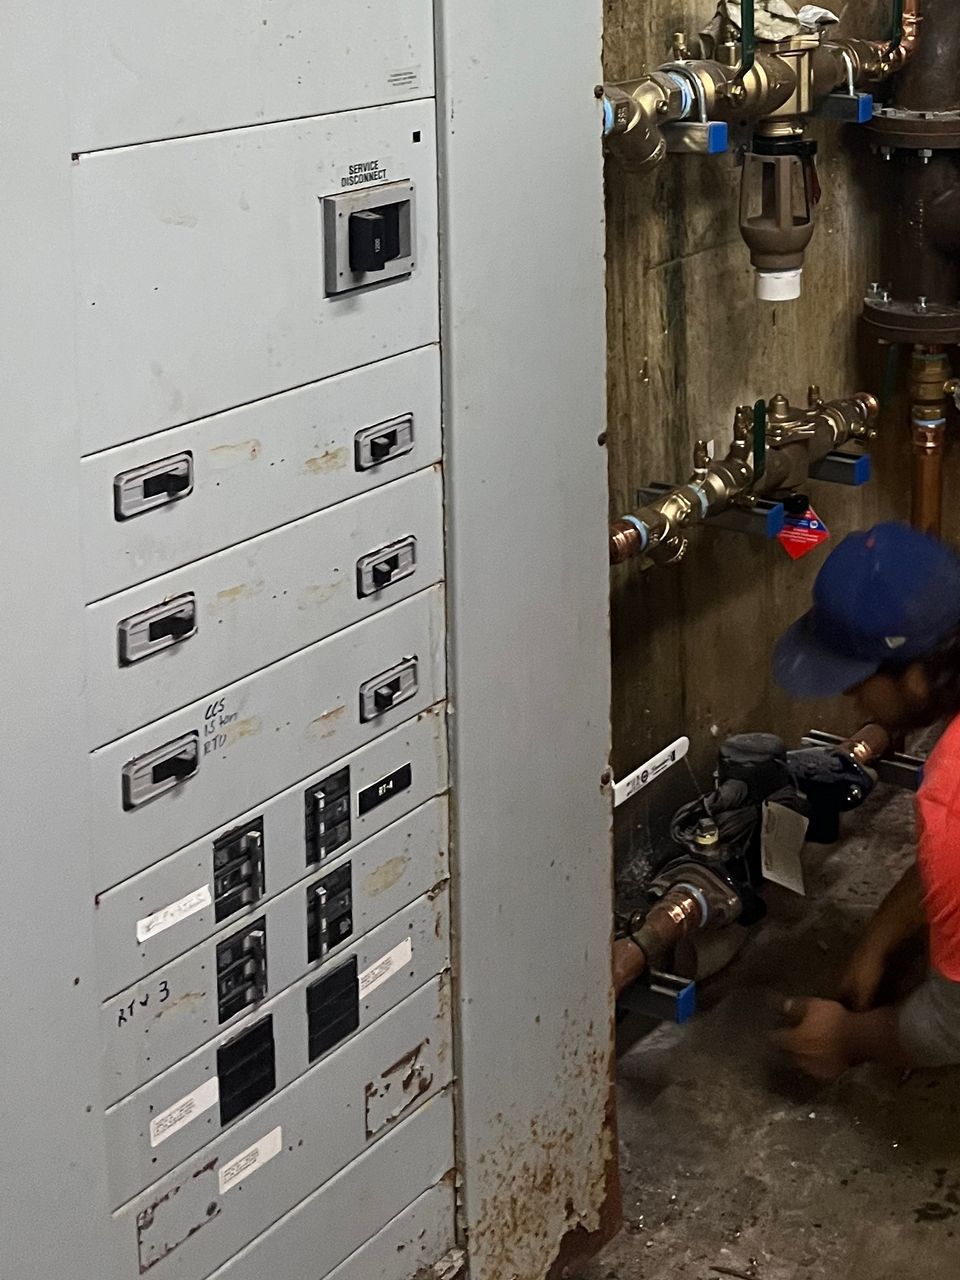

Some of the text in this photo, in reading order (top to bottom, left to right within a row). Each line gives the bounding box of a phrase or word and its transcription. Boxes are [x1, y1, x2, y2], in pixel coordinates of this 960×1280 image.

[349, 160, 379, 175] SERVICE
[341, 168, 387, 188] DISCONNECT
[158, 980, 170, 1003] 3
